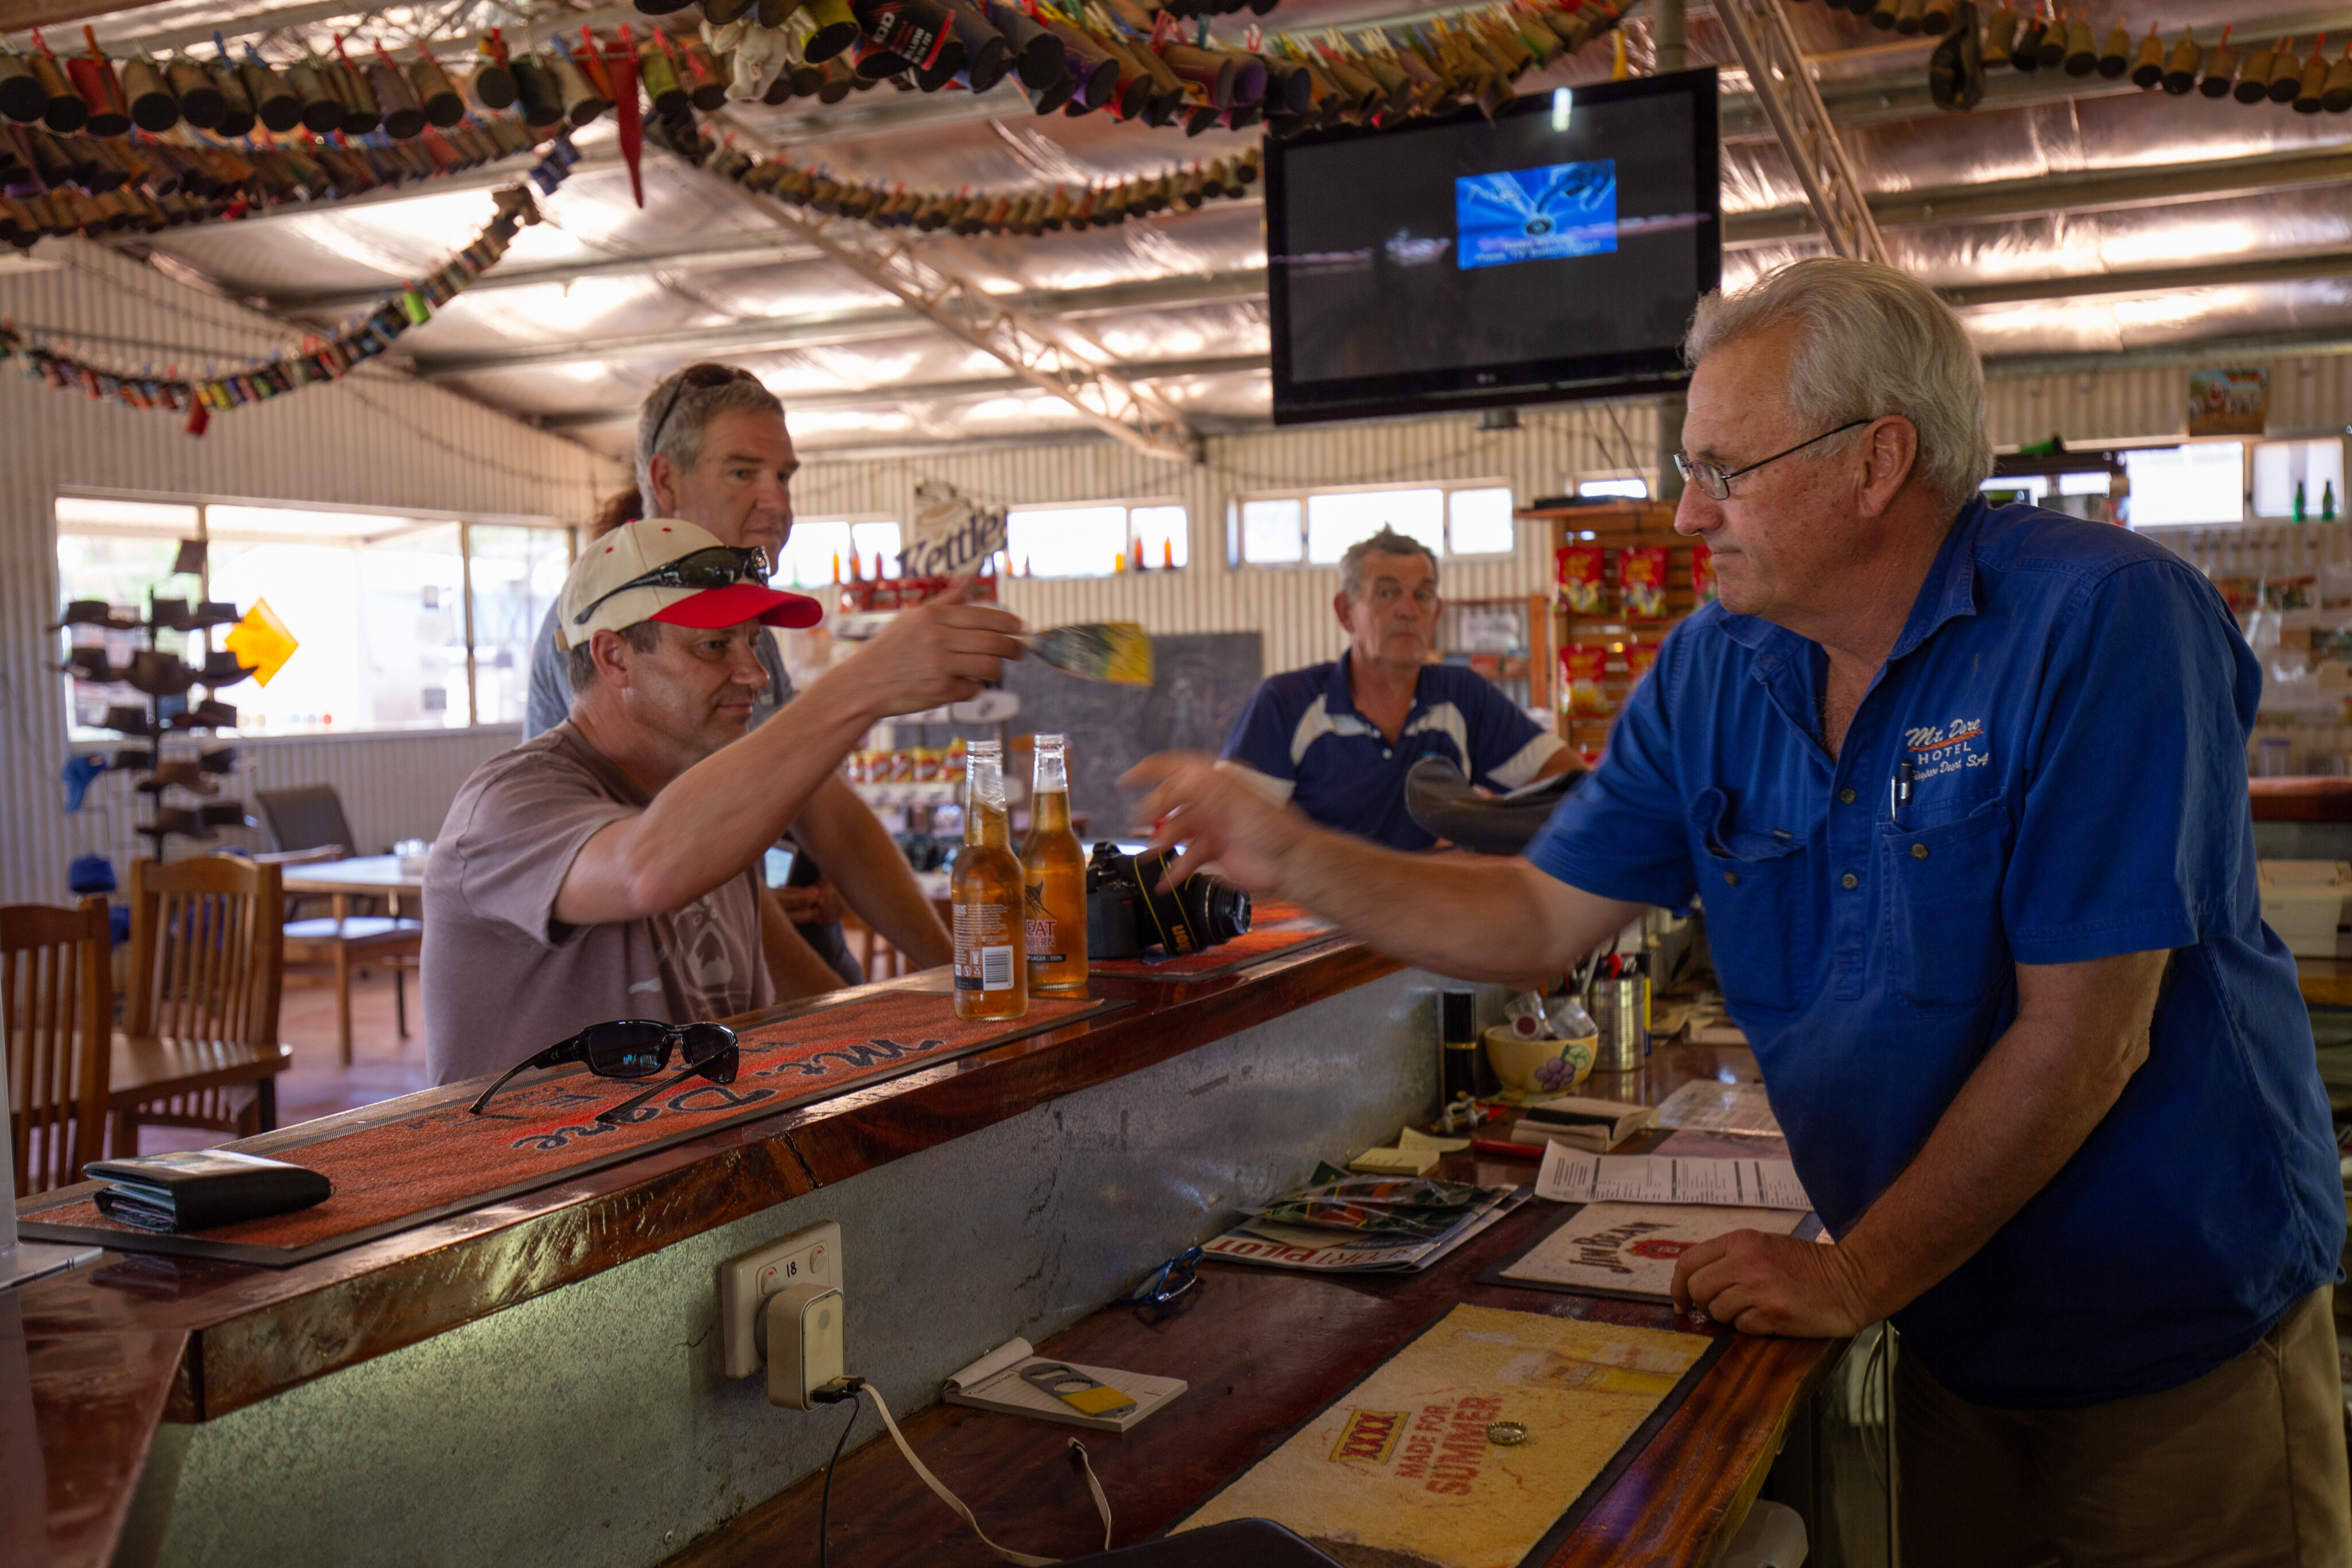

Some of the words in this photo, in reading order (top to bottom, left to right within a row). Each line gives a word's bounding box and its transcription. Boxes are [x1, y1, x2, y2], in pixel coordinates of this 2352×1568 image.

[896, 512, 999, 578] Kettle
[1905, 726, 1944, 747] Mt.
[1949, 718, 1981, 738] Dare
[1917, 741, 1972, 765] HOTEL
[1026, 920, 1057, 936] EAT
[754, 1039, 945, 1077] Mt.
[511, 1086, 777, 1150] Dare
[786, 1261, 797, 1278] 18
[1339, 1412, 1399, 1460] XXXX
[1414, 1404, 1452, 1433] FOR
[1394, 1434, 1437, 1479] MADE
[1424, 1396, 1503, 1496] SUMMER
